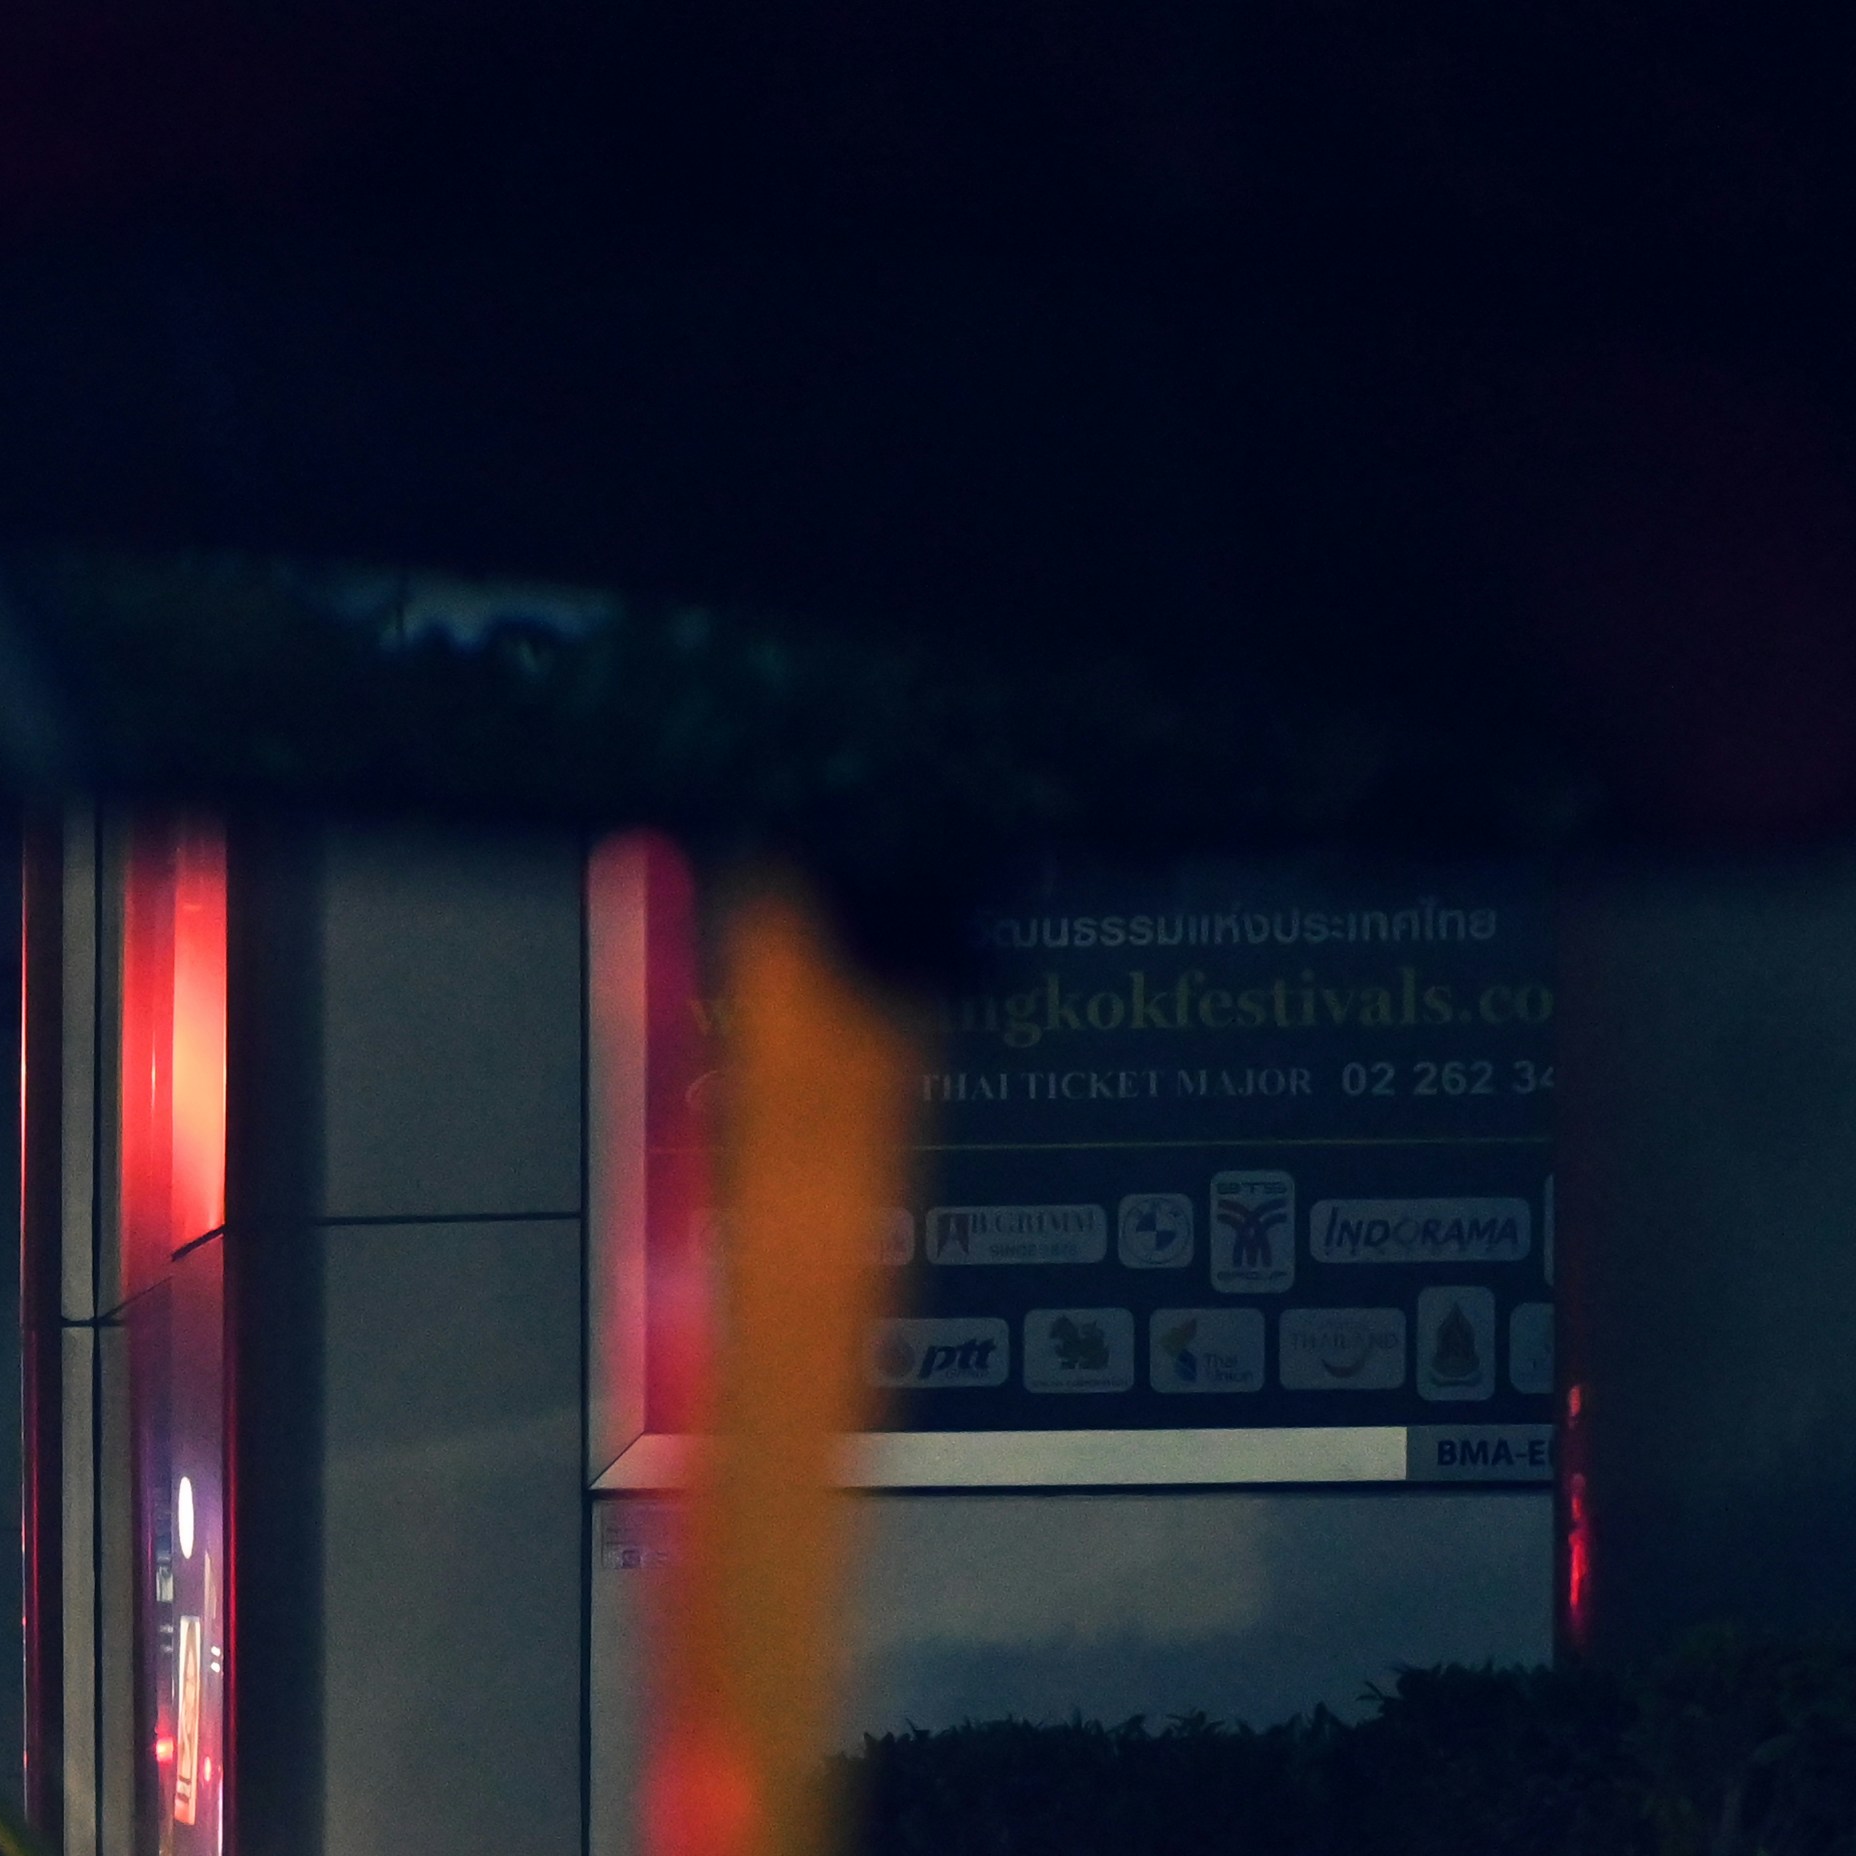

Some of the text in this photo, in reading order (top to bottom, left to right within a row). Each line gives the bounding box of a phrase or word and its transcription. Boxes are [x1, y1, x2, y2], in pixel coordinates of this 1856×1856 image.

[921, 1072, 1012, 1102] THAI
[1025, 1068, 1169, 1101] TICKET
[1175, 1065, 1313, 1099] MAJOR
[1340, 1060, 1396, 1097] 02
[1412, 1060, 1494, 1096] 262
[917, 1337, 997, 1379] ptt
